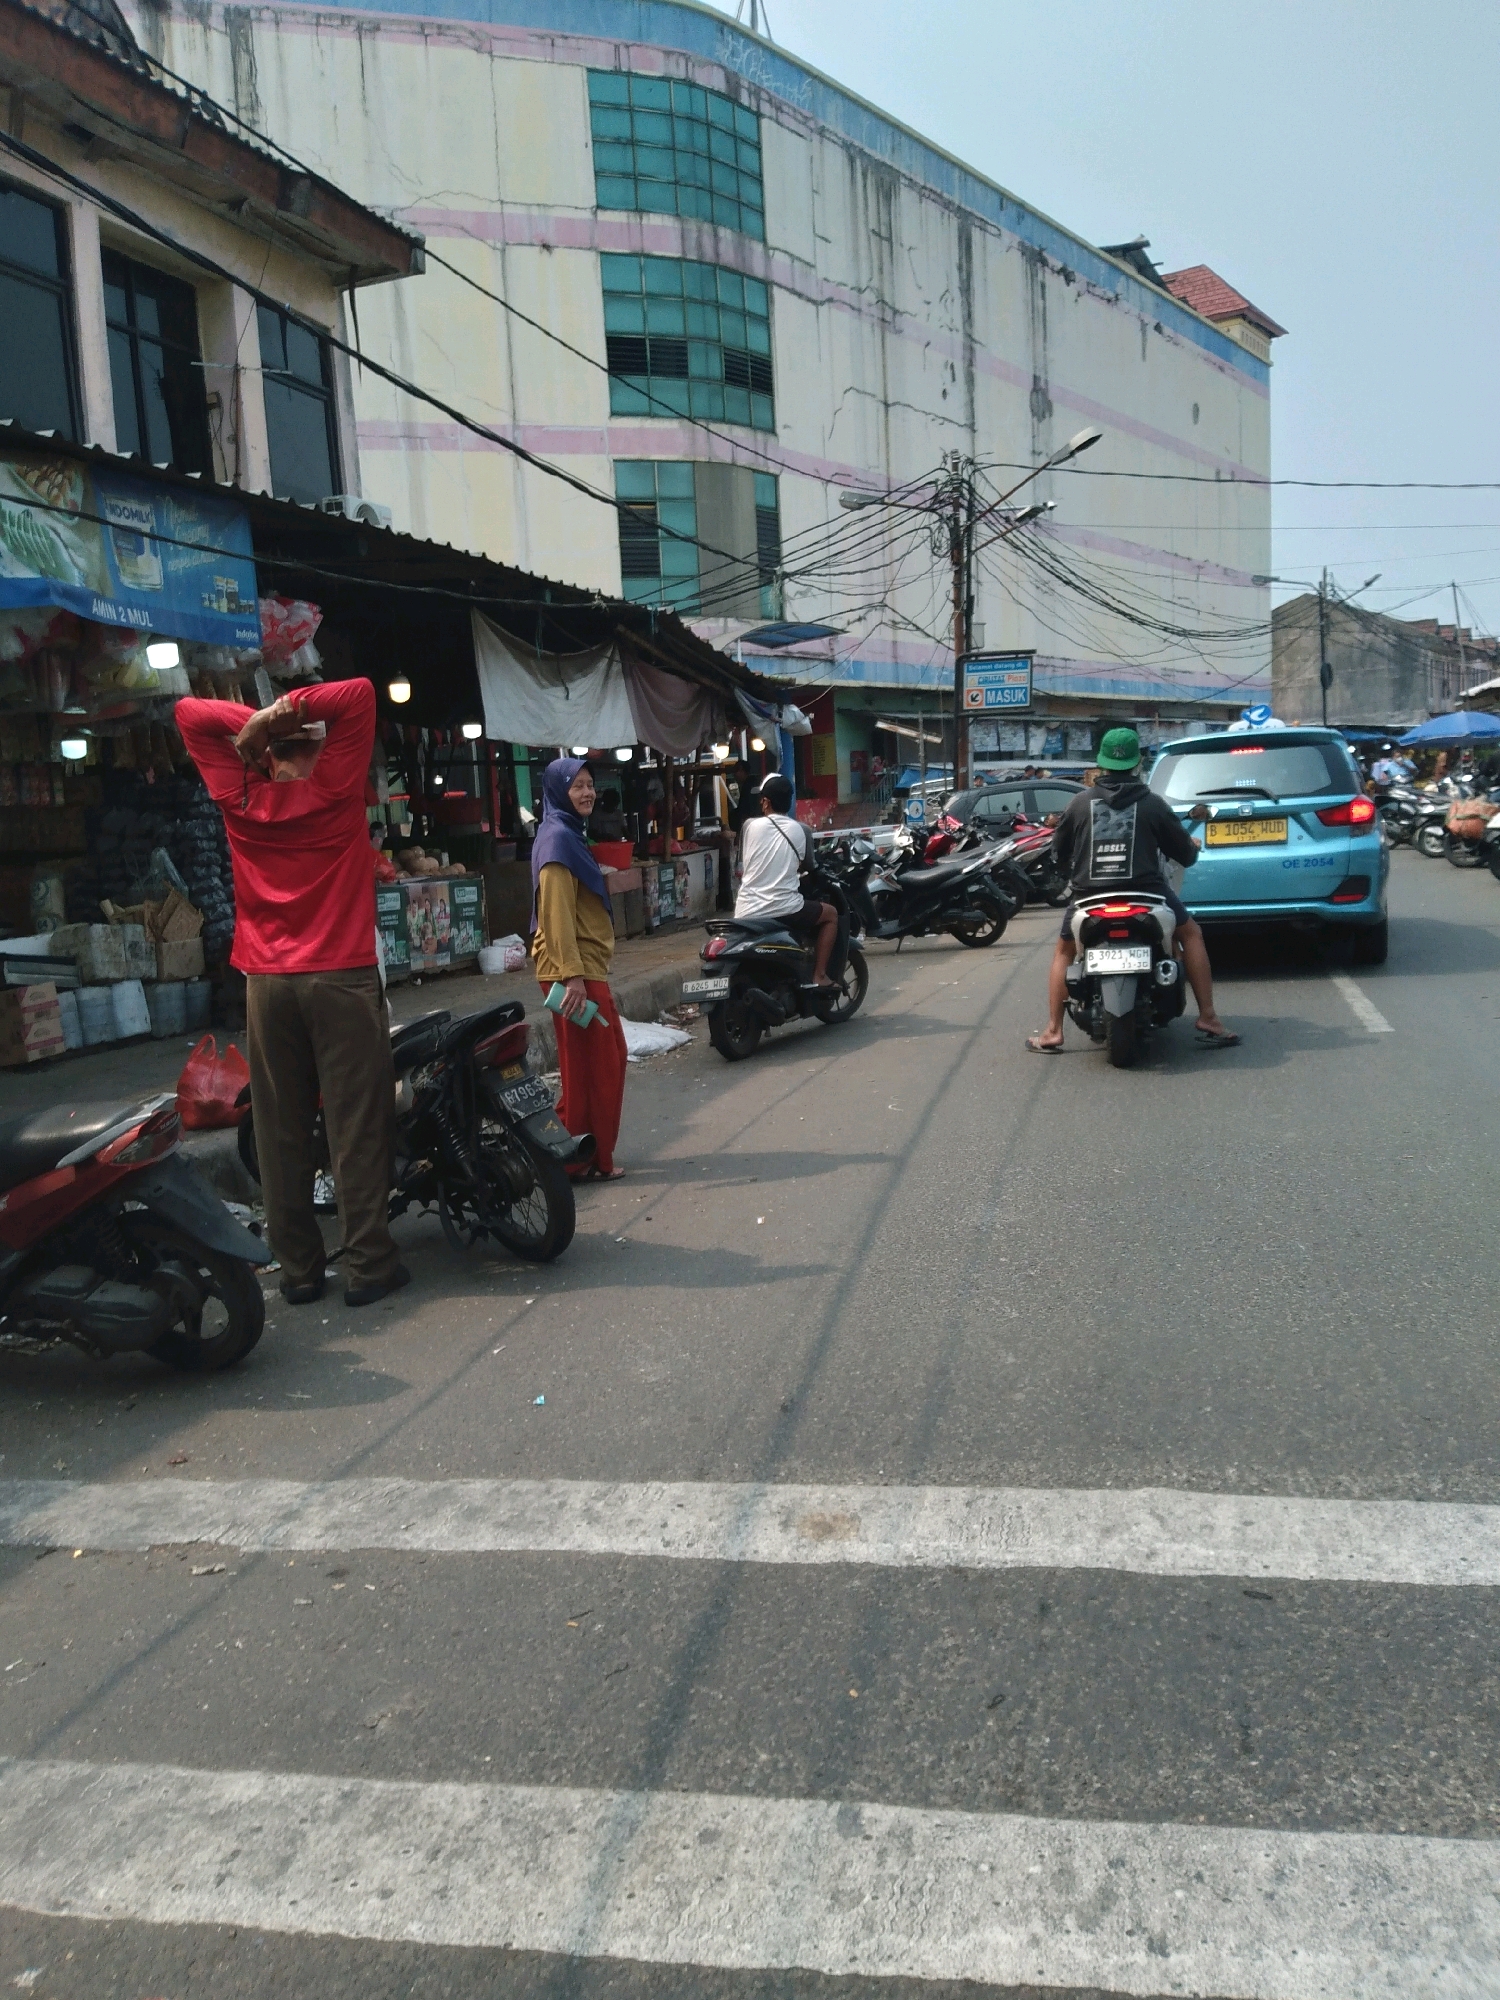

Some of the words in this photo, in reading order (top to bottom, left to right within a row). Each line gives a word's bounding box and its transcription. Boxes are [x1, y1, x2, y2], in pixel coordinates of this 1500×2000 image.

[92, 598, 117, 621] AMIN
[118, 605, 127, 622] 2
[127, 607, 154, 628] MUL
[986, 688, 1026, 704] MASUK
[1209, 824, 1217, 837] B
[1282, 858, 1300, 869] OE
[1304, 857, 1334, 868] 2054
[1088, 951, 1095, 961] B
[1099, 949, 1123, 960] 3921
[504, 1083, 536, 1104] 6796
